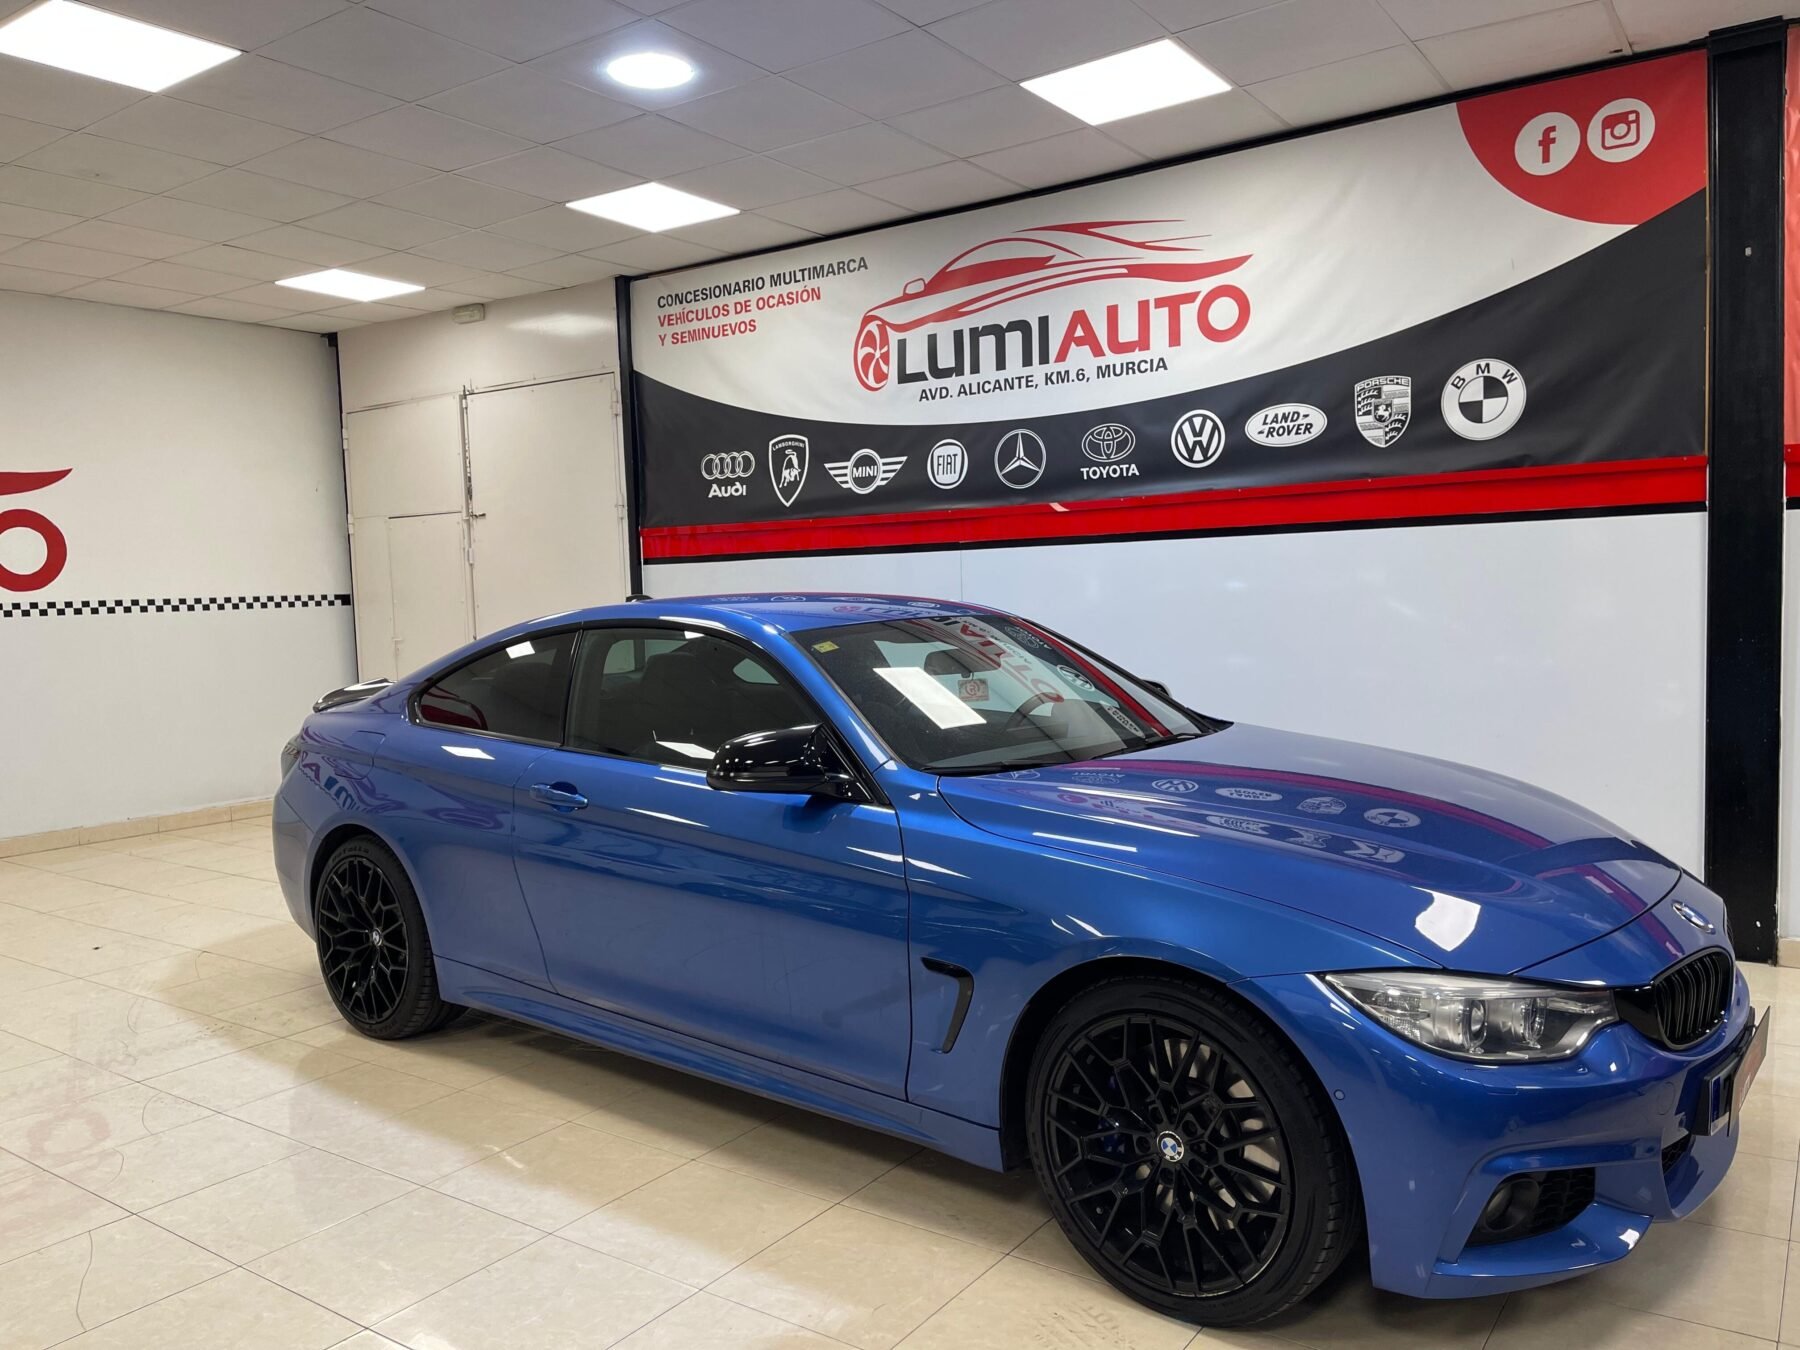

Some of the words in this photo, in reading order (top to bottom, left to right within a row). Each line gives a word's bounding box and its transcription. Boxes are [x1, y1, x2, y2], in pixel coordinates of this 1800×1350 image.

[657, 276, 766, 309] CONCESIONARIO
[769, 256, 869, 288] MULTIMARCA
[657, 303, 730, 328] VEHÍCULOS
[734, 300, 752, 315] DE
[756, 285, 822, 311] OCASIÓN
[658, 334, 668, 347] Y
[671, 318, 757, 345] SEMINUEVOS
[918, 387, 954, 402] AVD.
[957, 373, 1040, 398] ALICANTE,
[1044, 368, 1091, 388] KM.6,
[1096, 356, 1169, 380] MURCIA
[1356, 376, 1410, 392] PORSCHE
[1450, 362, 1519, 391] BMW
[852, 464, 878, 478] MINI
[936, 453, 958, 477] FIAT
[1080, 463, 1140, 480] TOYOTA
[707, 481, 747, 498] Audi
